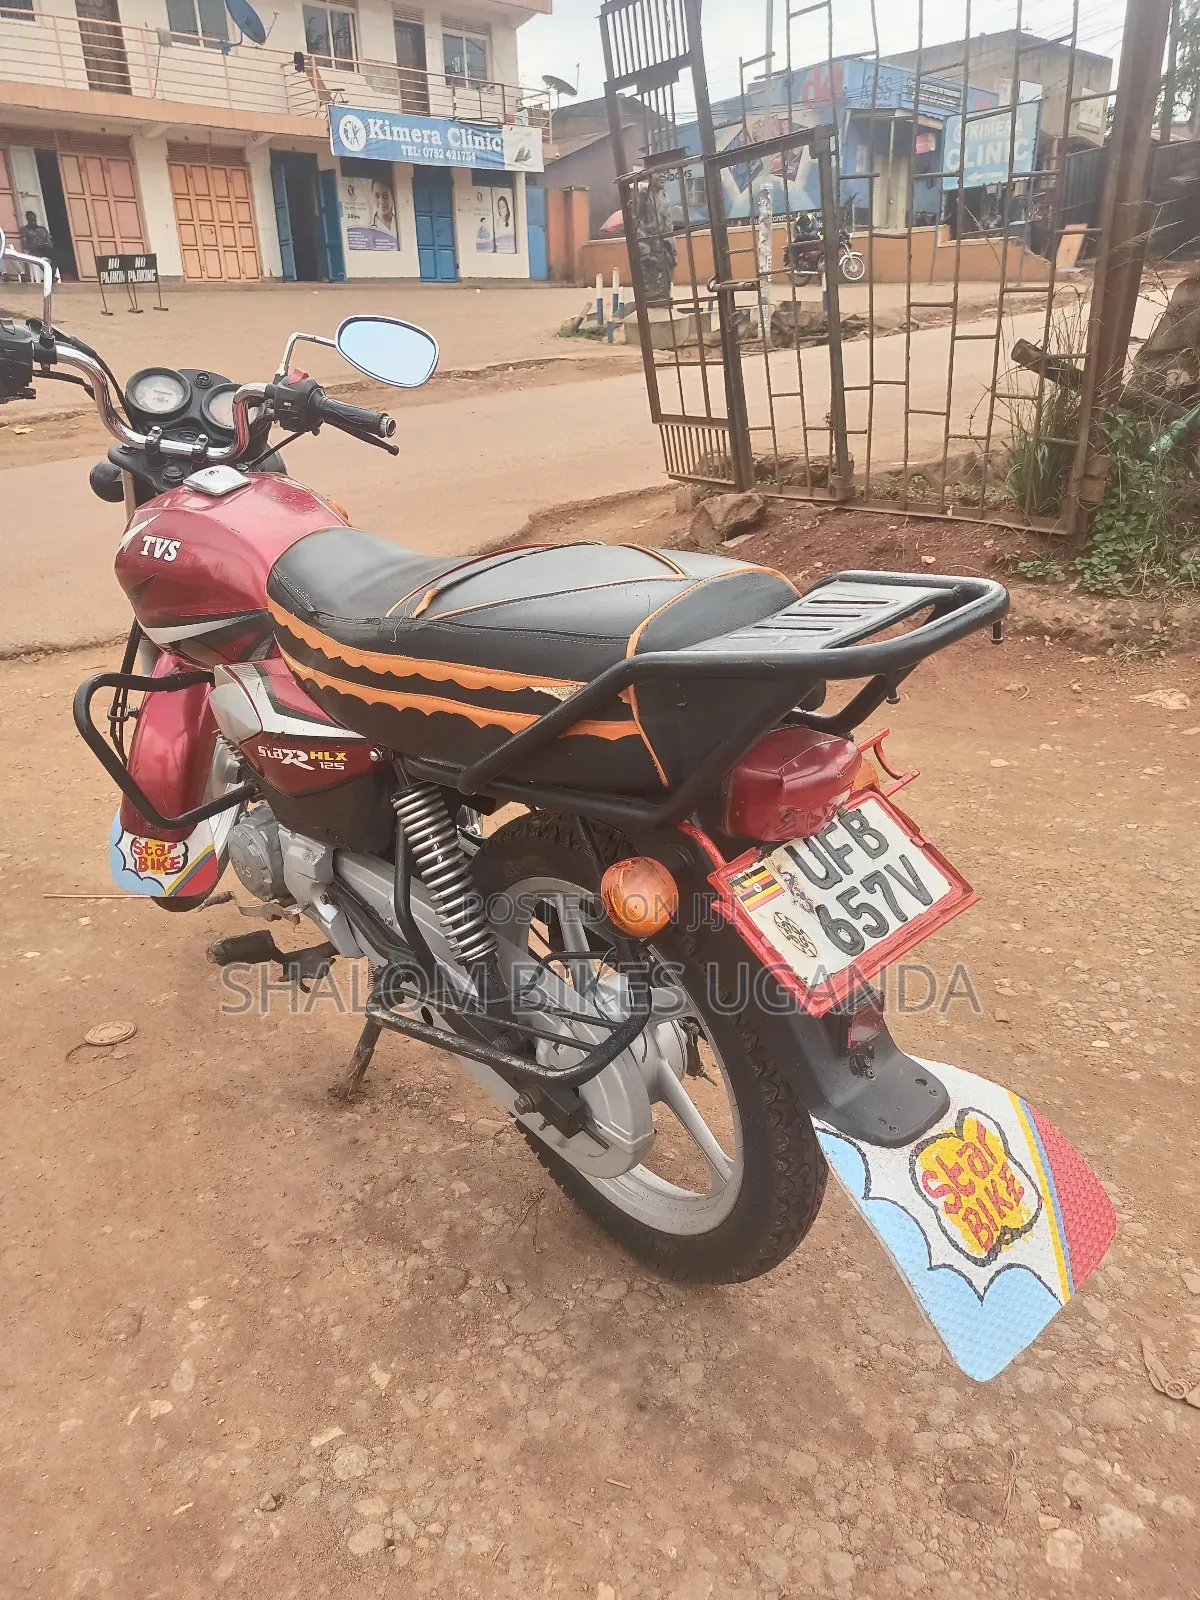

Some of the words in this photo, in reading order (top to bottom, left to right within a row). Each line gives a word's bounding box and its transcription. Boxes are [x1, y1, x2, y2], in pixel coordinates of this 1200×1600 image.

[367, 118, 442, 146] Kimera
[447, 127, 502, 151] Clinic
[401, 145, 421, 156] TEL:
[423, 148, 444, 159] 0752
[108, 258, 120, 270] NO
[135, 257, 146, 268] NO
[100, 270, 126, 284] PARKIN
[127, 269, 156, 283] PARKING
[140, 534, 182, 562] TVS
[310, 751, 348, 761] HLX
[319, 762, 345, 770] 125
[132, 839, 178, 856] Star
[784, 808, 890, 890] UFB
[138, 855, 182, 873] BIKE
[815, 854, 934, 956] 657V
[921, 1120, 998, 1215] Star
[962, 1162, 1025, 1253] BIKE
